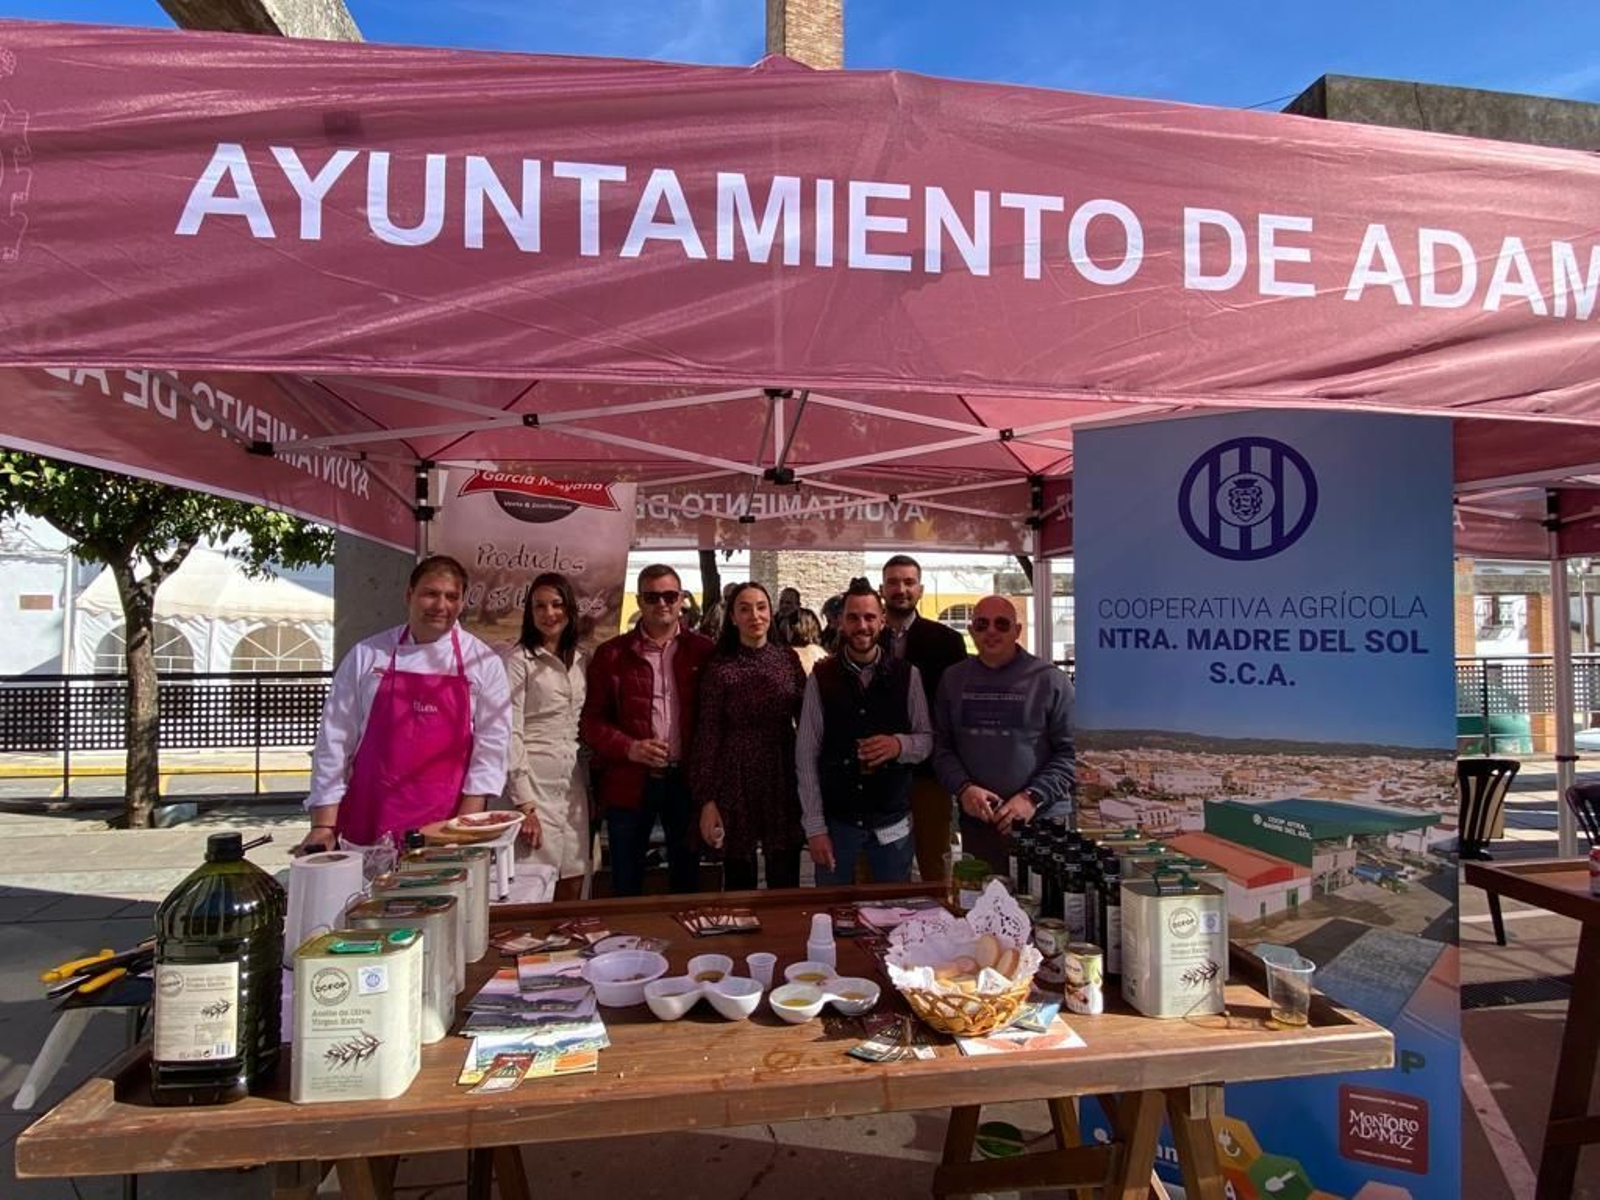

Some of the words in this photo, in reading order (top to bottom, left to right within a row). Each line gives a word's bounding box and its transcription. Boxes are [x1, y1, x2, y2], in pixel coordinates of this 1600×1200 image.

[175, 142, 1145, 287] AYUNTAMIENTO
[1183, 206, 1316, 299] DE
[1344, 223, 1600, 320] ADAM
[1098, 597, 1272, 620] COOPERATIVA
[1280, 590, 1429, 620] AGRÍCOLA
[1098, 627, 1178, 652] NTRA.
[1187, 628, 1290, 653] MADRE
[1299, 629, 1356, 654] DEL
[1364, 629, 1430, 655] SOL
[1209, 662, 1296, 688] S.C.A.
